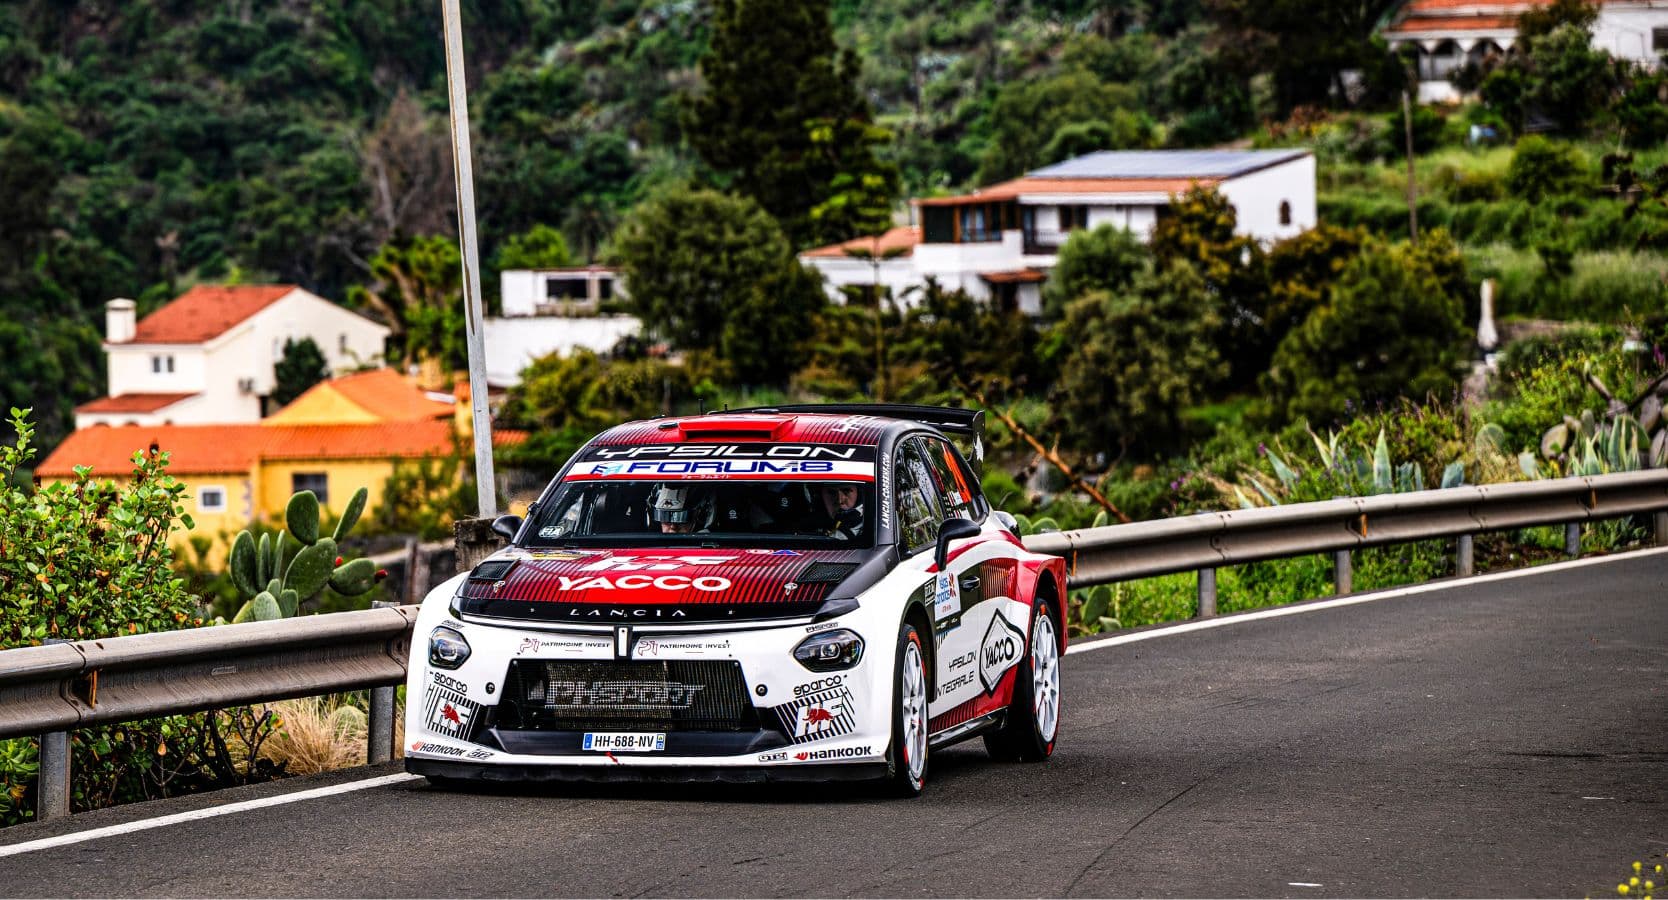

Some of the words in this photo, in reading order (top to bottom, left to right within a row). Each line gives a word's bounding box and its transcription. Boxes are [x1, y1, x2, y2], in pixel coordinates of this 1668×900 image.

[596, 445, 856, 459] YPSILON
[627, 461, 833, 473] FORUM8
[558, 575, 732, 592] YACCO
[569, 608, 686, 617] LANCIA
[948, 650, 977, 673] YPSILON
[985, 637, 1015, 670] YACCO
[434, 671, 468, 693] sparco
[793, 675, 843, 698] sparco
[937, 671, 975, 697] NTEGRALE
[594, 735, 655, 747] HH-688-NV
